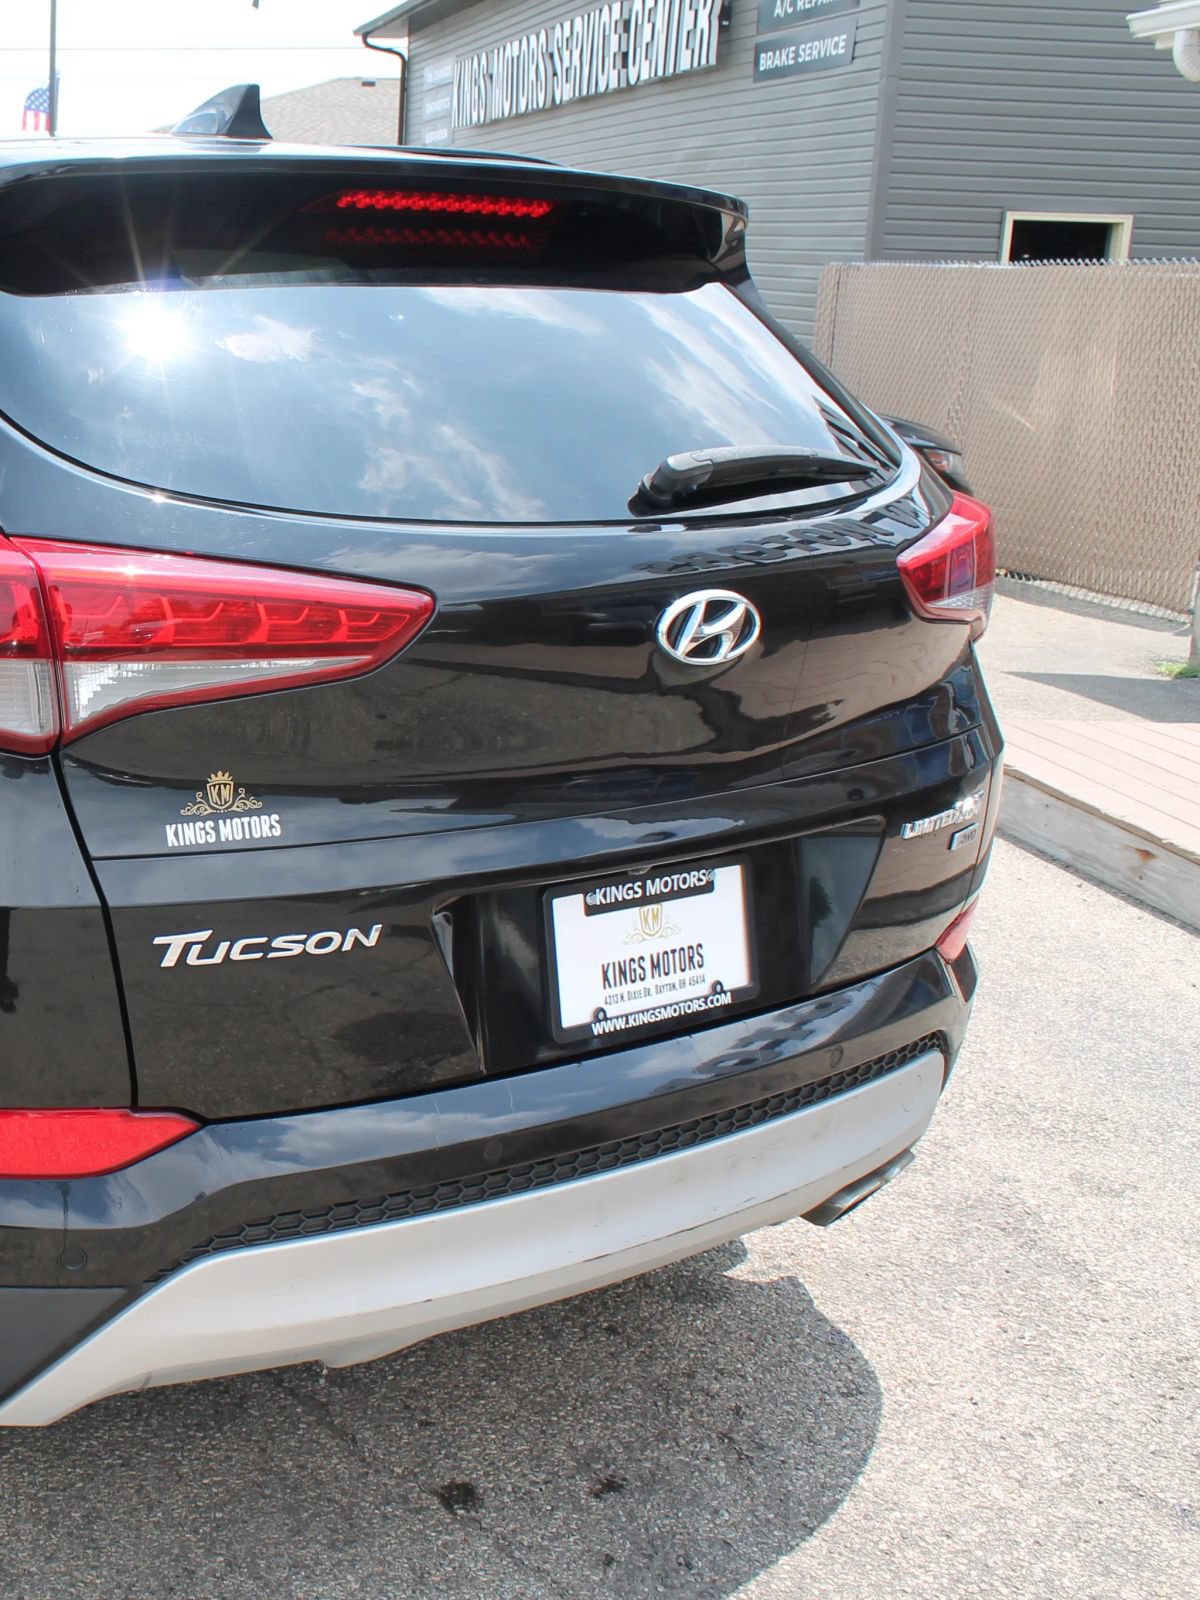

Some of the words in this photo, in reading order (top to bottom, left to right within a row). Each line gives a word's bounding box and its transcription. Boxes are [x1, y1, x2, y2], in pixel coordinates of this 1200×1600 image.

[451, 51, 489, 129] KINGS
[491, 28, 549, 120] MOTORS
[553, 1, 625, 106] SERVICE
[627, 0, 717, 86] CENTER
[759, 46, 797, 72] BRAKE
[798, 34, 848, 63] SERVICE
[210, 783, 232, 805] KM
[165, 820, 216, 847] KINGS
[220, 814, 281, 842] MOTORS
[595, 881, 643, 905] KINGS
[645, 869, 708, 897] MOTORS
[152, 924, 383, 968] TUCSON
[601, 955, 645, 990] KINGS
[650, 943, 705, 980] MOTORS
[592, 992, 732, 1036] WWW.KINGSMOTORS.COM
